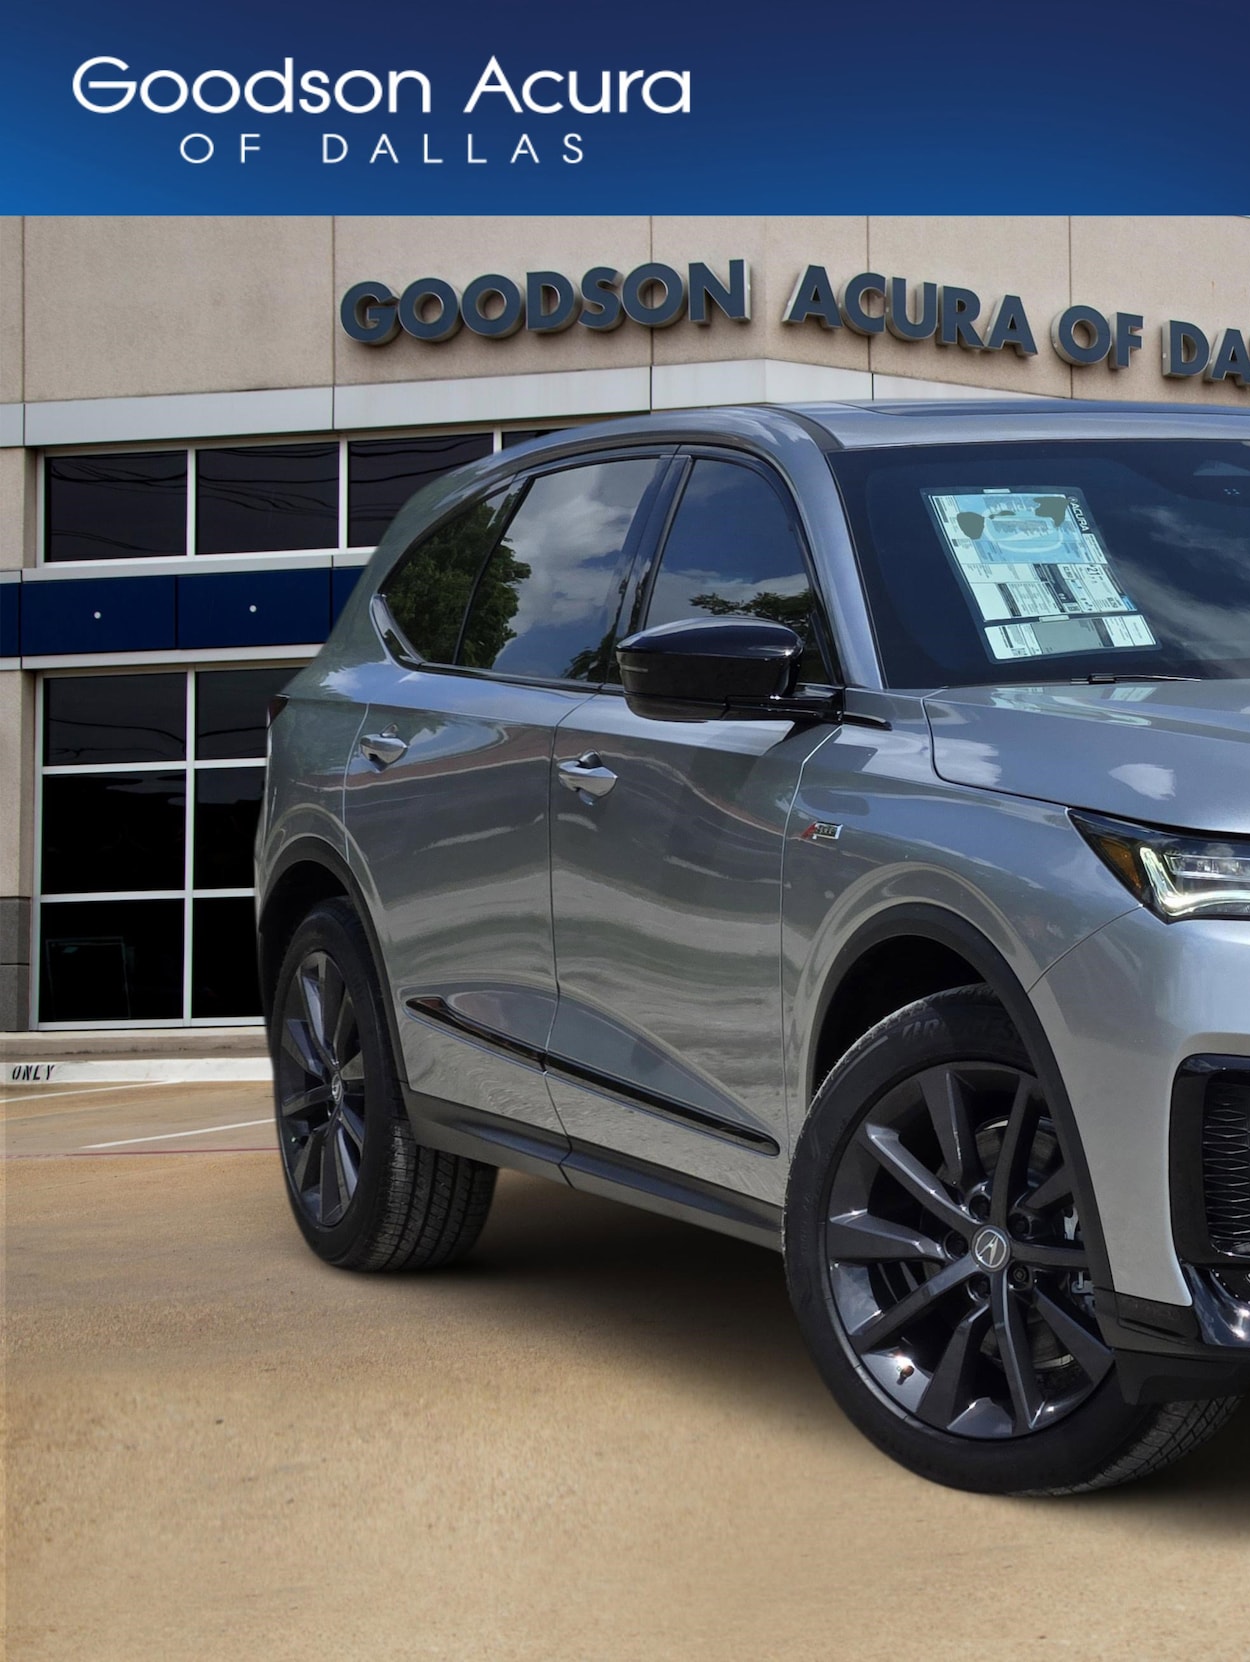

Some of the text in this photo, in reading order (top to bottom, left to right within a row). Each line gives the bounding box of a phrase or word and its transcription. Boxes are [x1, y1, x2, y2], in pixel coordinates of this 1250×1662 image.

[340, 259, 751, 346] GOODSON
[782, 264, 1039, 356] ACURA
[1051, 305, 1143, 370] OF
[1070, 502, 1090, 532] ACURA
[12, 1065, 55, 1081] ONLY
